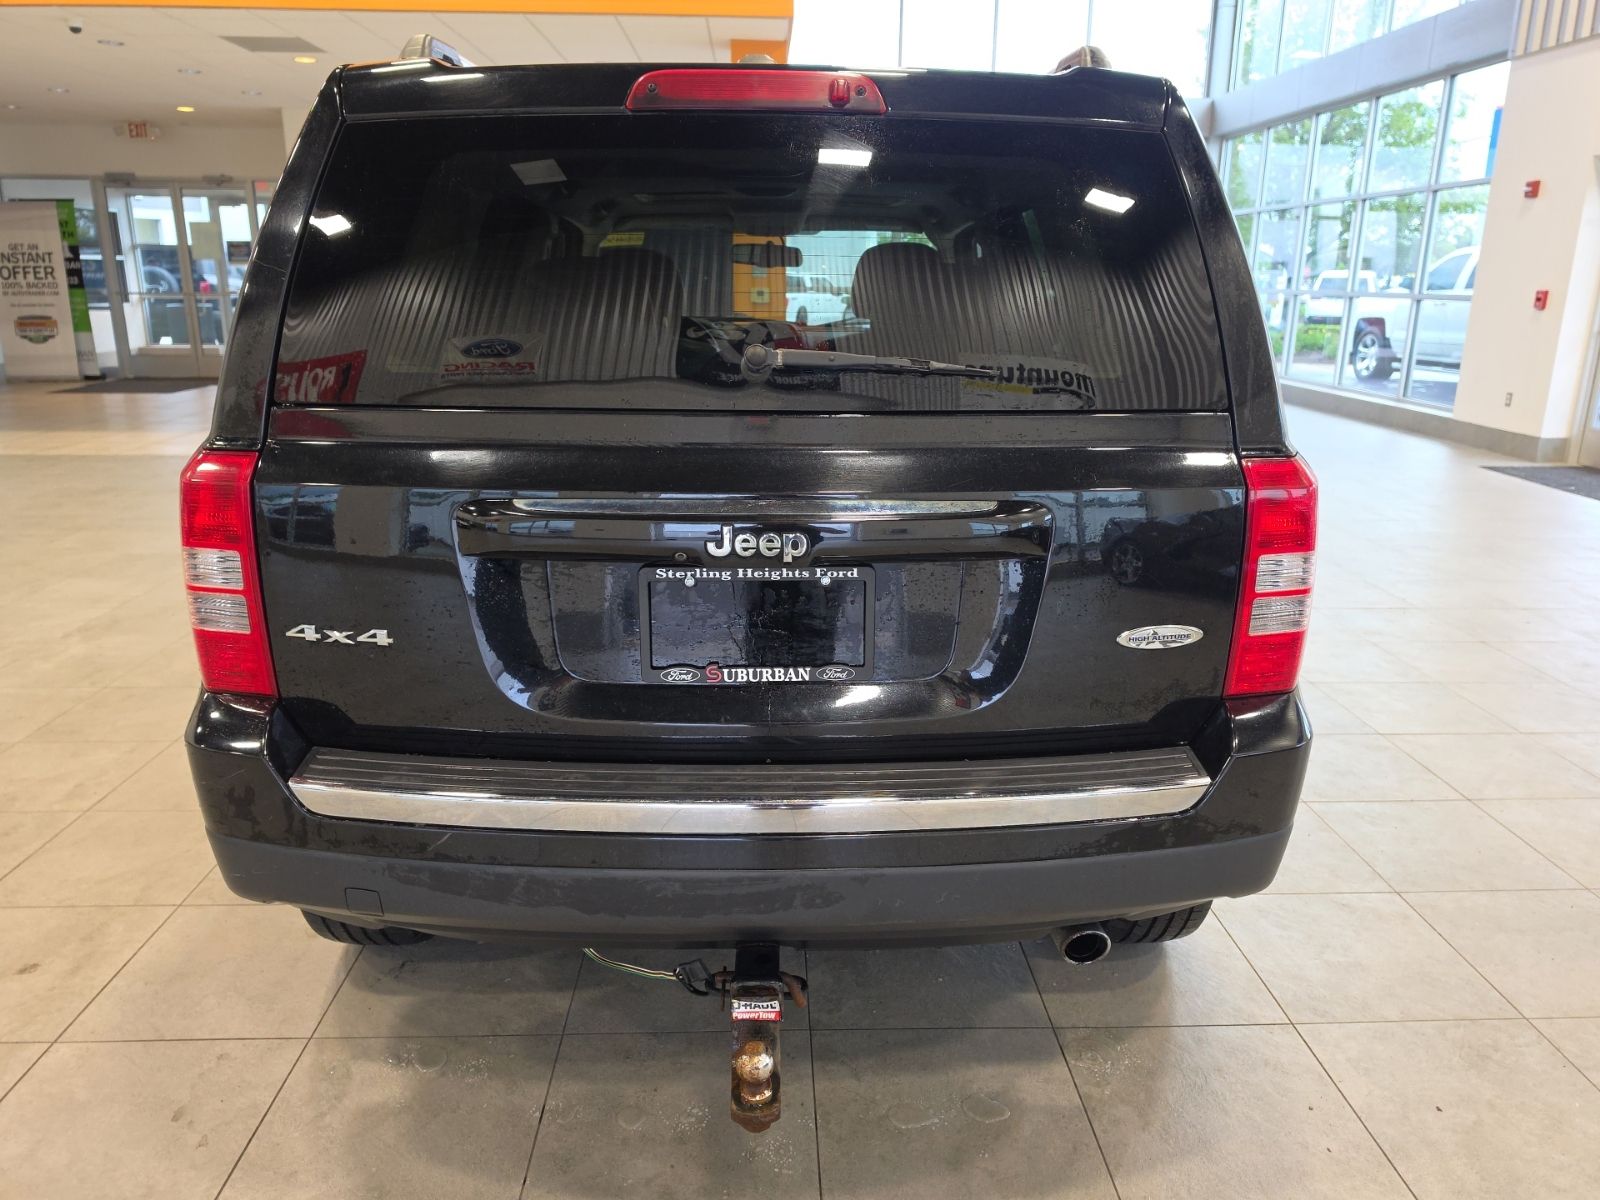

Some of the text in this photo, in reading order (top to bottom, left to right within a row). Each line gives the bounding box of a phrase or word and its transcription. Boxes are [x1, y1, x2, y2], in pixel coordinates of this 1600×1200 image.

[128, 122, 148, 138] EXIT
[8, 243, 39, 251] GET AN
[0, 251, 53, 264] NSTANT
[0, 265, 56, 280] OFFER
[1, 281, 58, 289] 100% BACKED
[705, 524, 808, 563] Jeep
[655, 567, 859, 581] Sterling Heights Ford
[285, 624, 394, 646] 4x4
[1152, 633, 1192, 641] ALTITUDE
[665, 664, 850, 683] Ford SUBURBAN Ford
